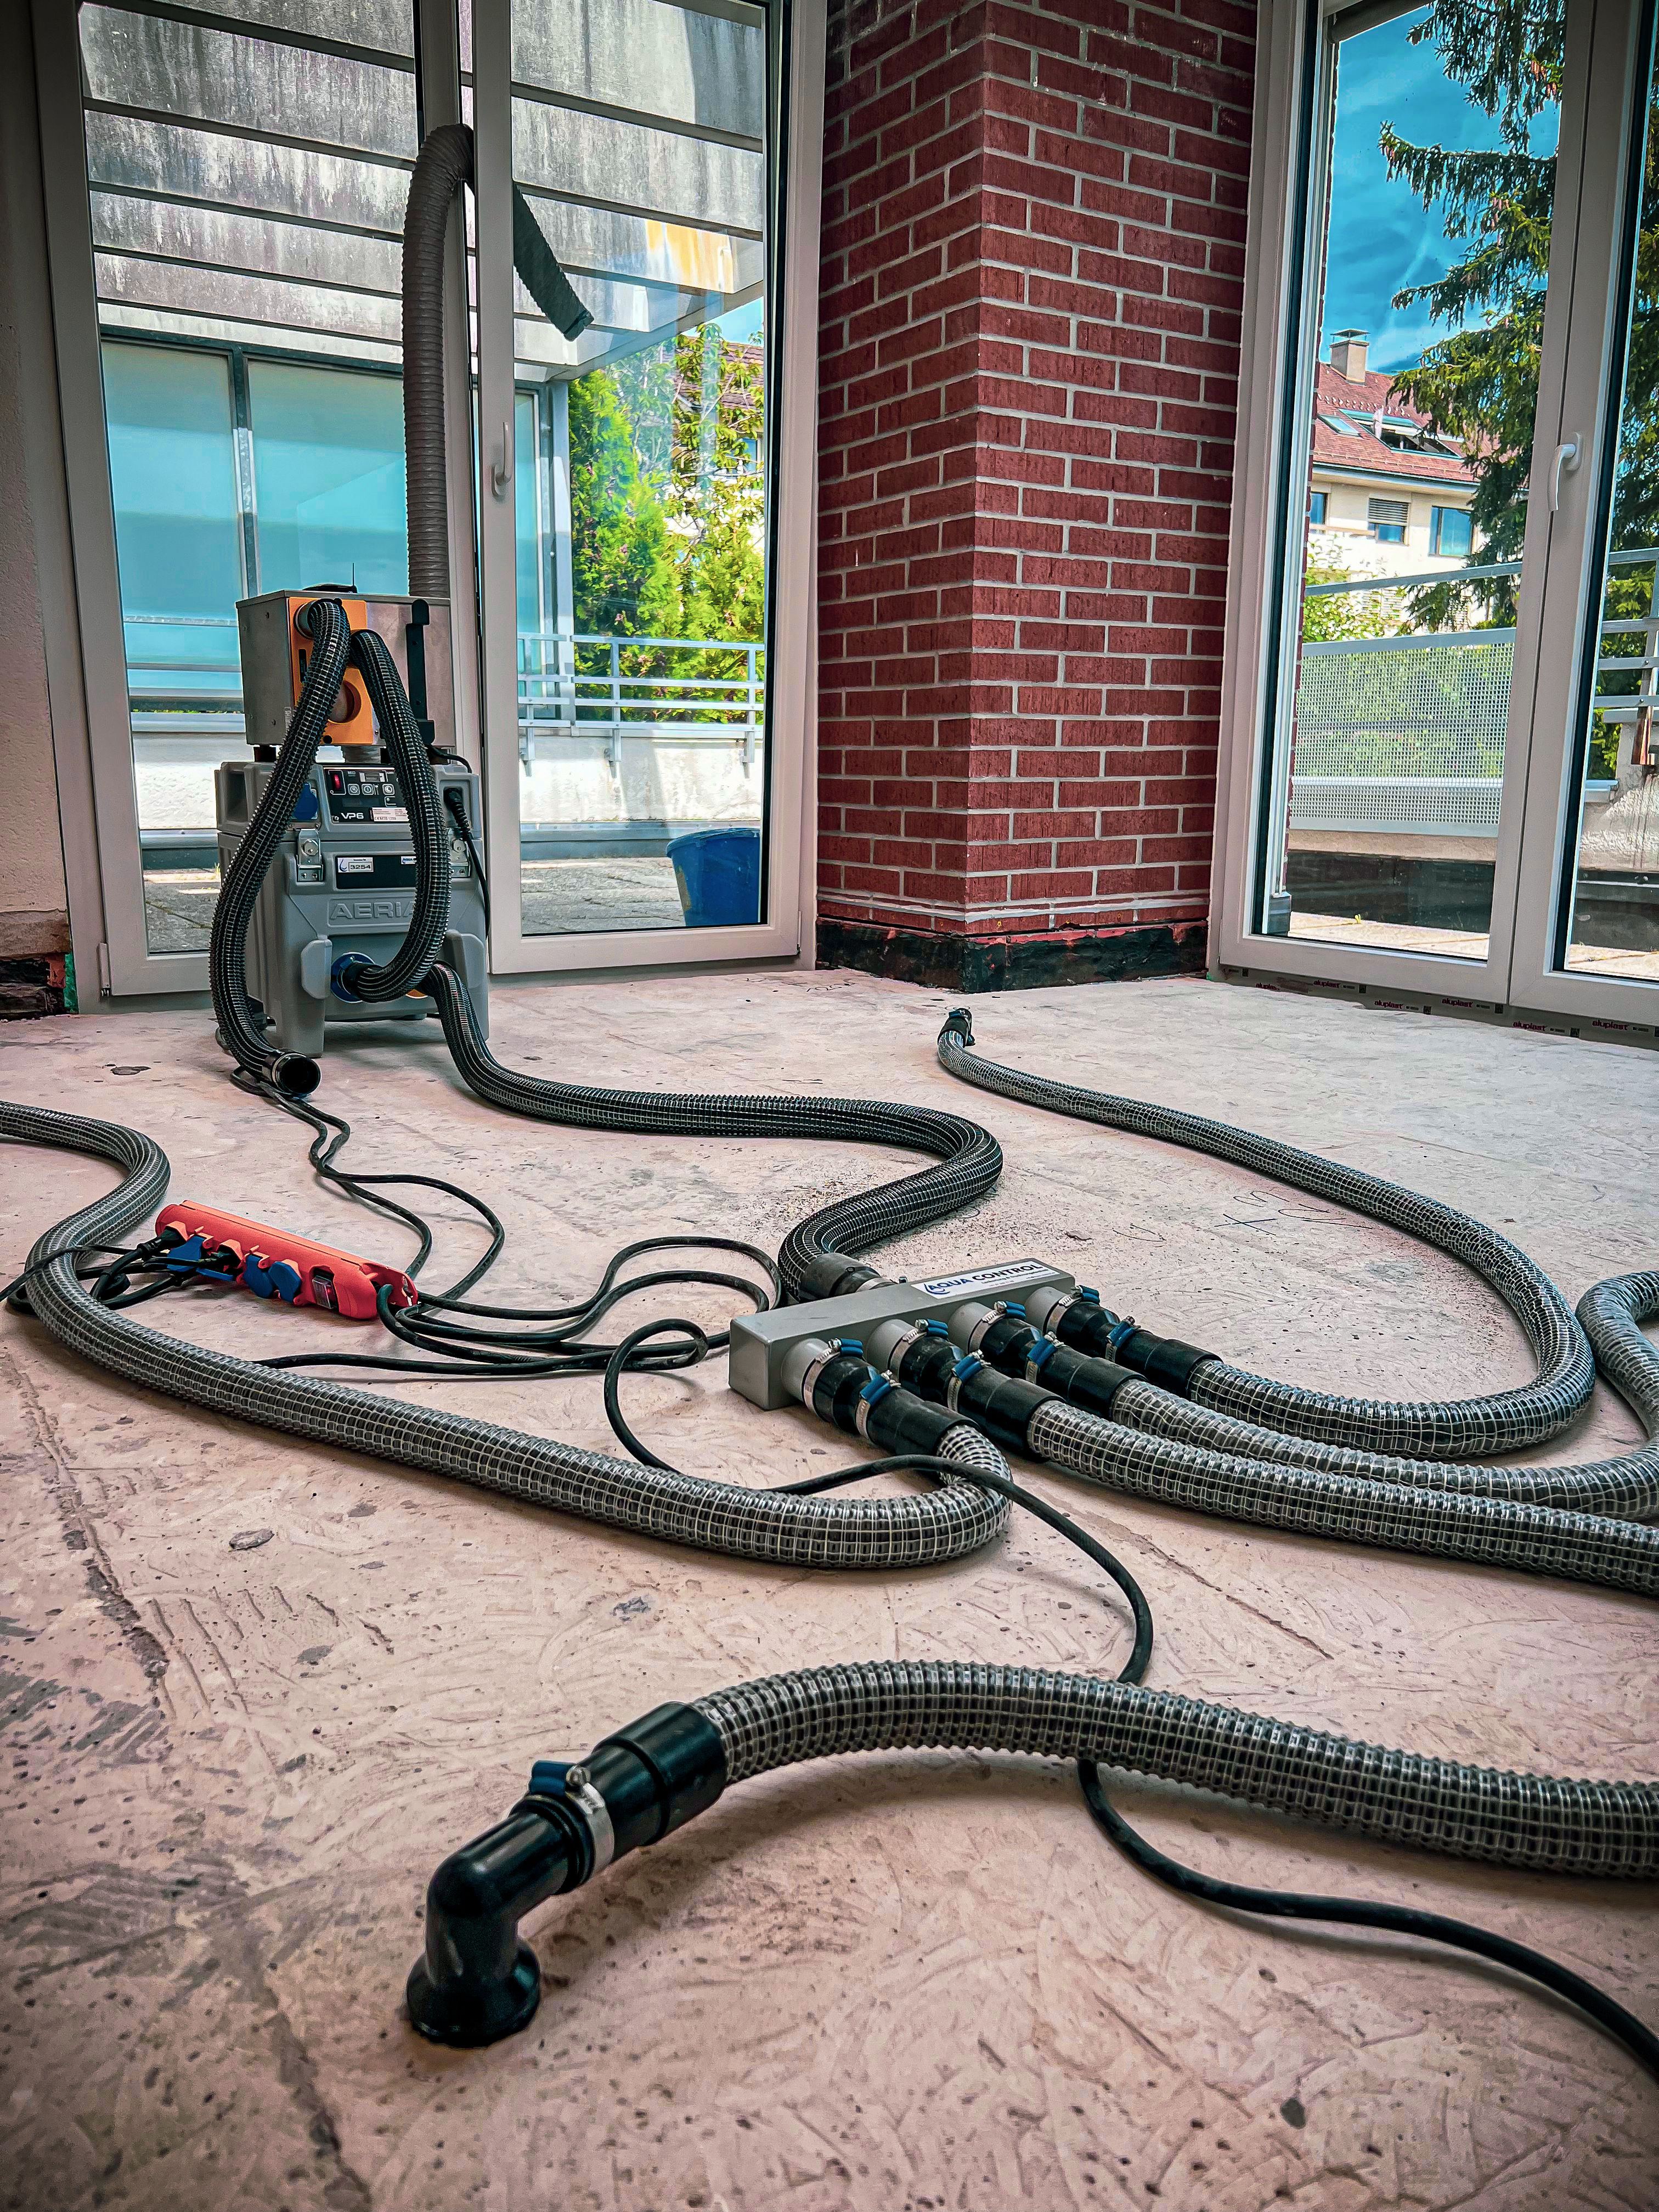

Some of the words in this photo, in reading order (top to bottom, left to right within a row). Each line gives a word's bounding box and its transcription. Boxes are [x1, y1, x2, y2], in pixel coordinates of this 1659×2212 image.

[1313, 979, 1340, 989] aluplast
[1374, 1000, 1404, 1010] aluplast
[1441, 997, 1474, 1008] aluplast
[1513, 1020, 1547, 1032] aluplast
[1592, 1019, 1629, 1031] aluplast
[927, 1277, 974, 1291] AQUA
[972, 1263, 1043, 1281] CONTROL
